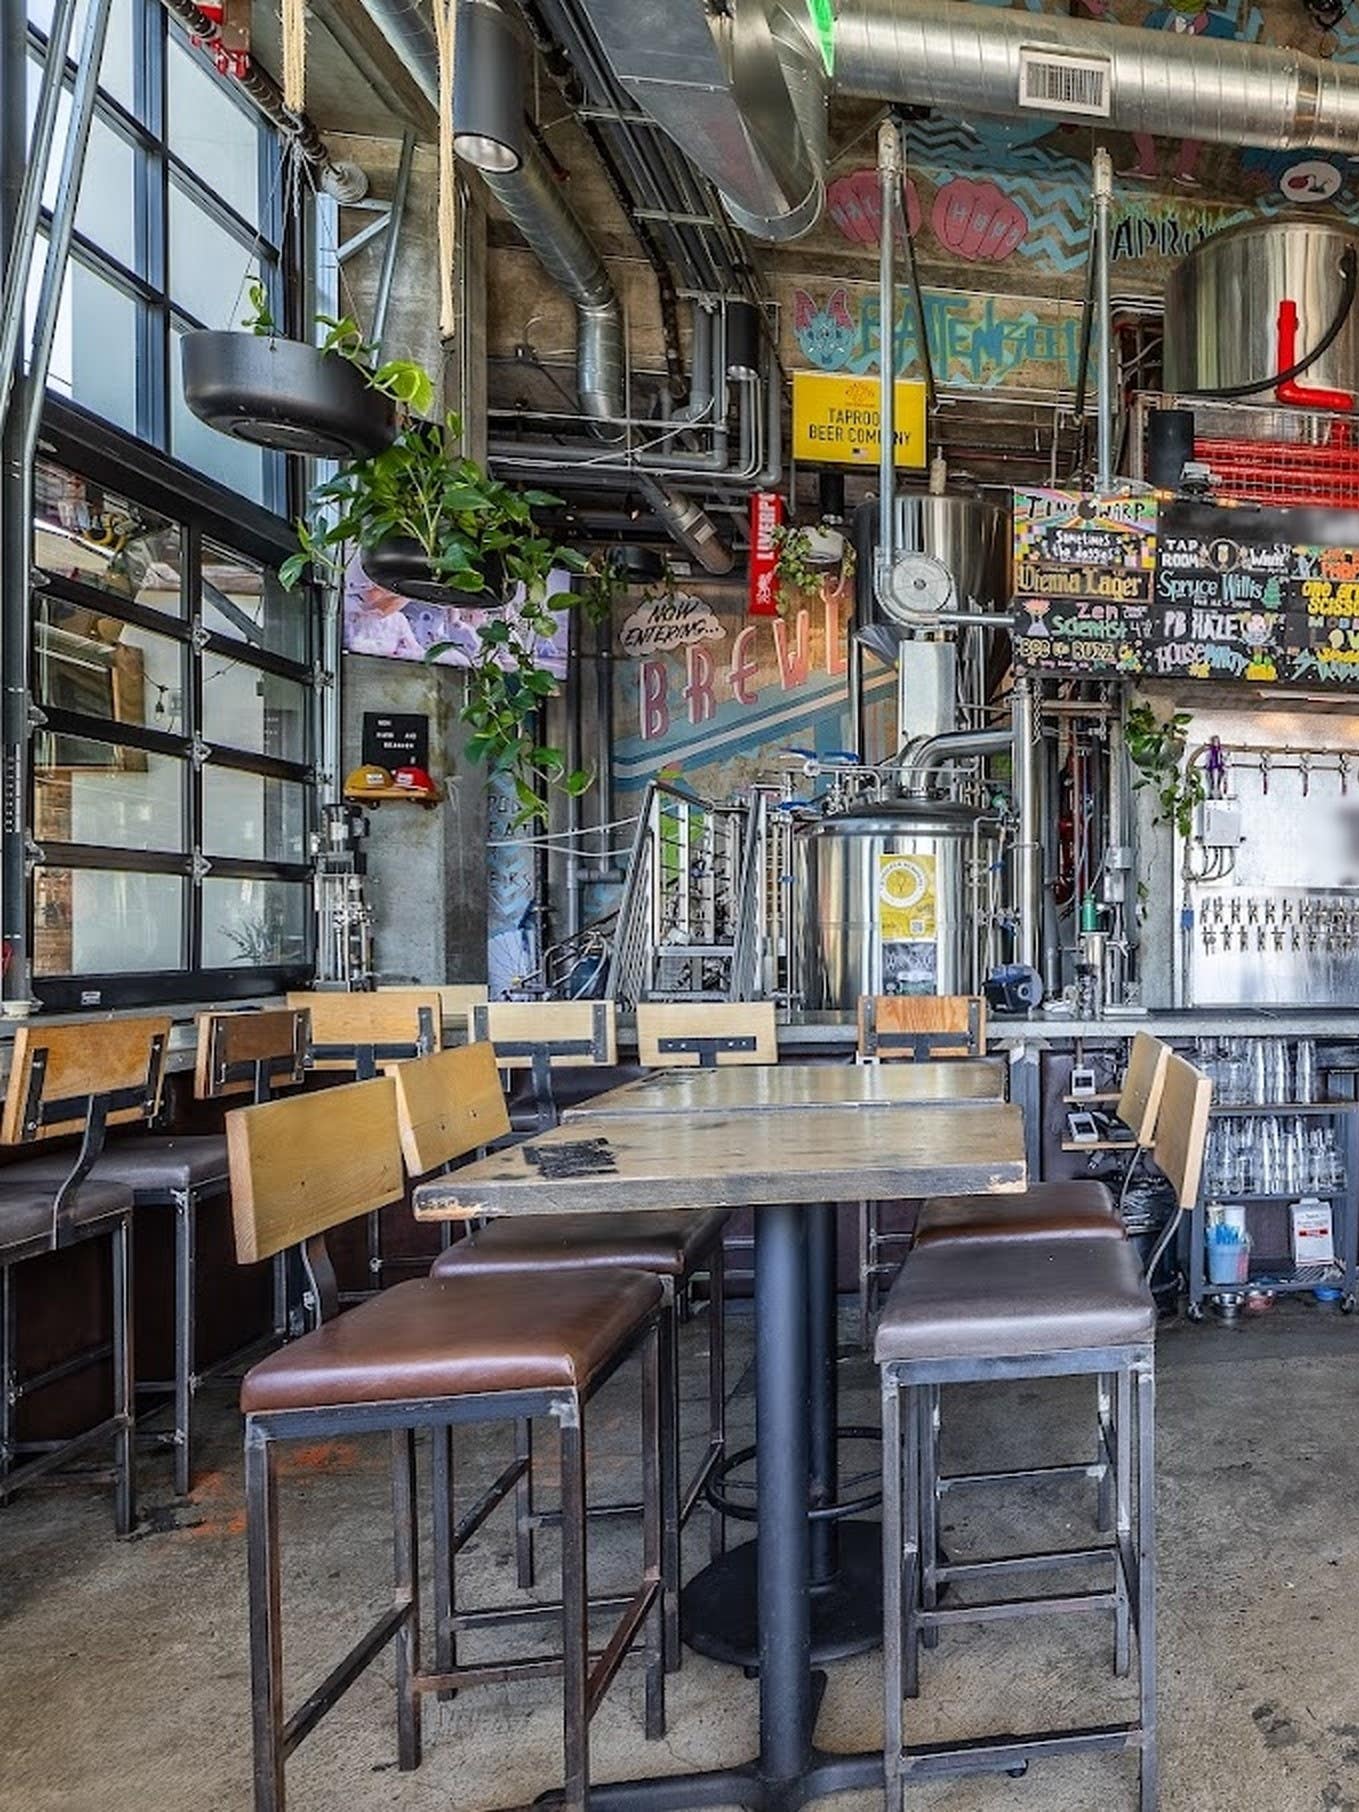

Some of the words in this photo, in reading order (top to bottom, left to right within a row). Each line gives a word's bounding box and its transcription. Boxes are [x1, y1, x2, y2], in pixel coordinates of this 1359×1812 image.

[828, 407, 881, 427] TAPROO
[809, 424, 844, 442] BEER
[848, 427, 912, 446] COMNY
[1165, 540, 1199, 552] TAP
[1157, 570, 1218, 603] Spruce
[651, 601, 697, 620] NOW
[1076, 602, 1119, 620] Zen
